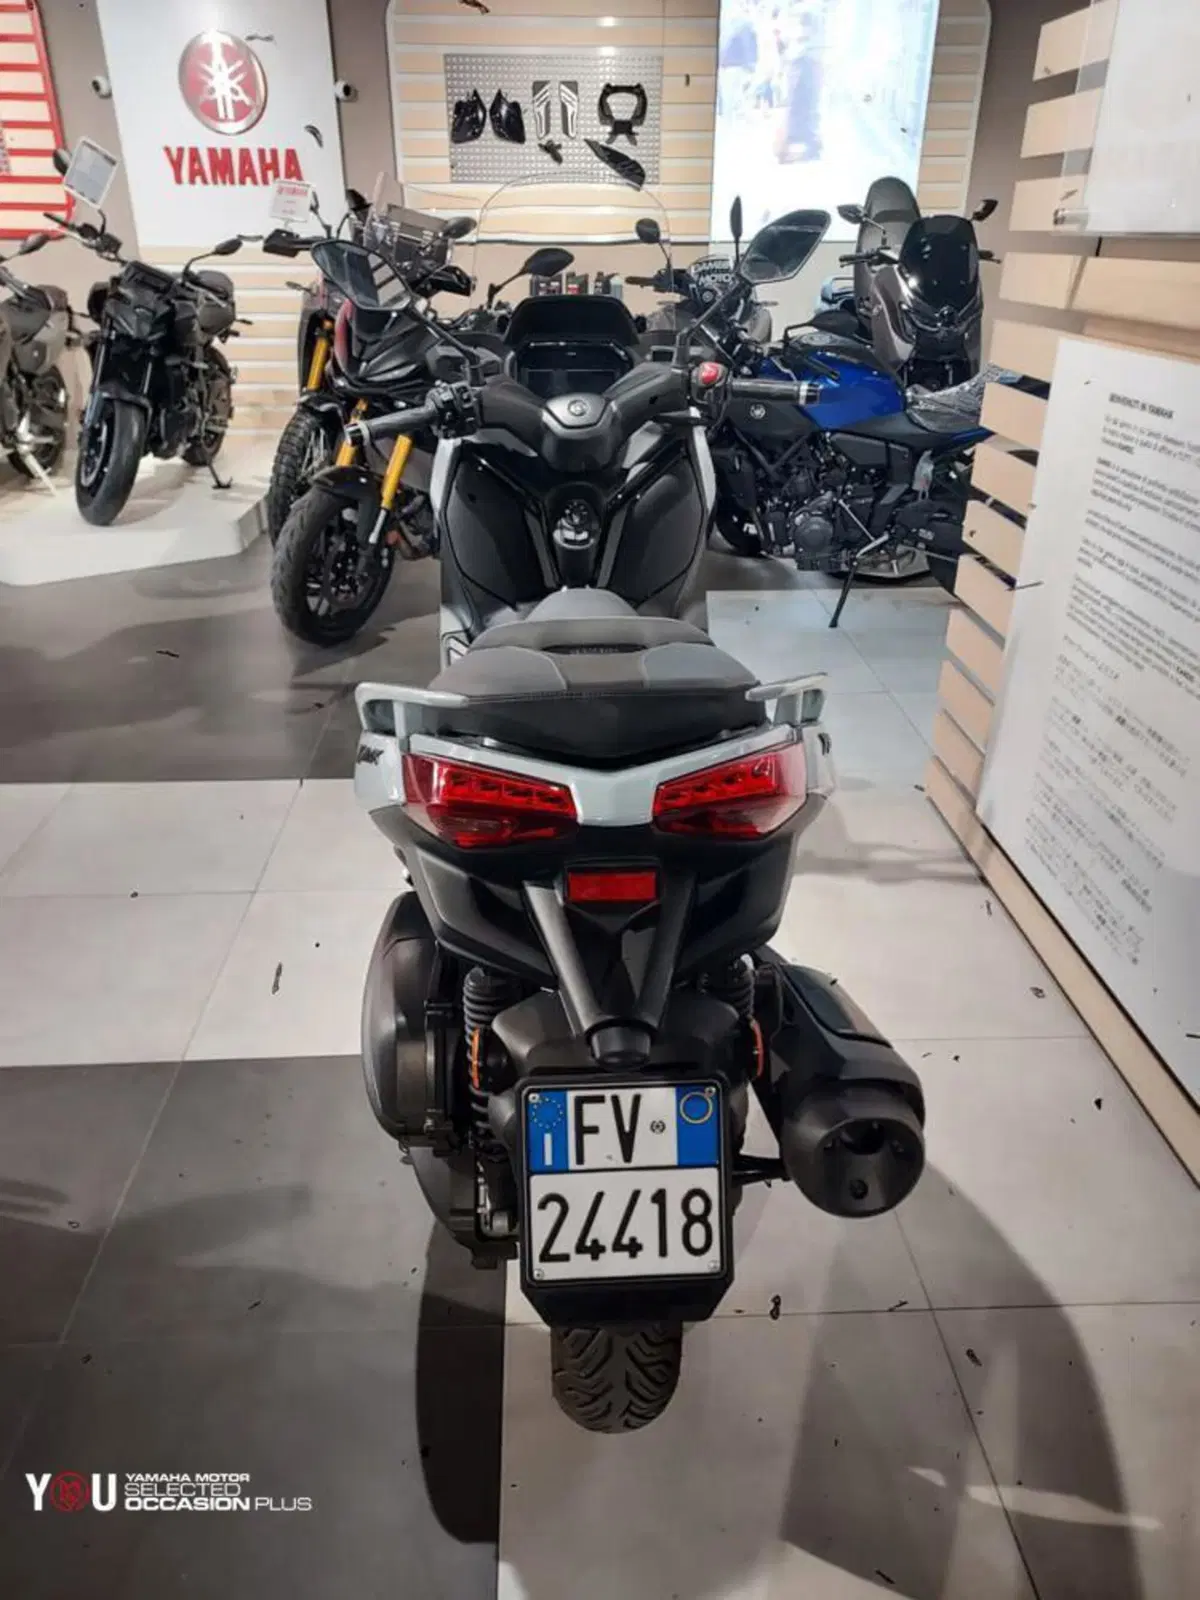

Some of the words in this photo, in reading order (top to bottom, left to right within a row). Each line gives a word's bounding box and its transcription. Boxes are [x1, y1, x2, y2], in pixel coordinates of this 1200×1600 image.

[163, 145, 304, 186] YAMAHA
[573, 1093, 642, 1166] FV
[537, 1187, 714, 1264] 24418
